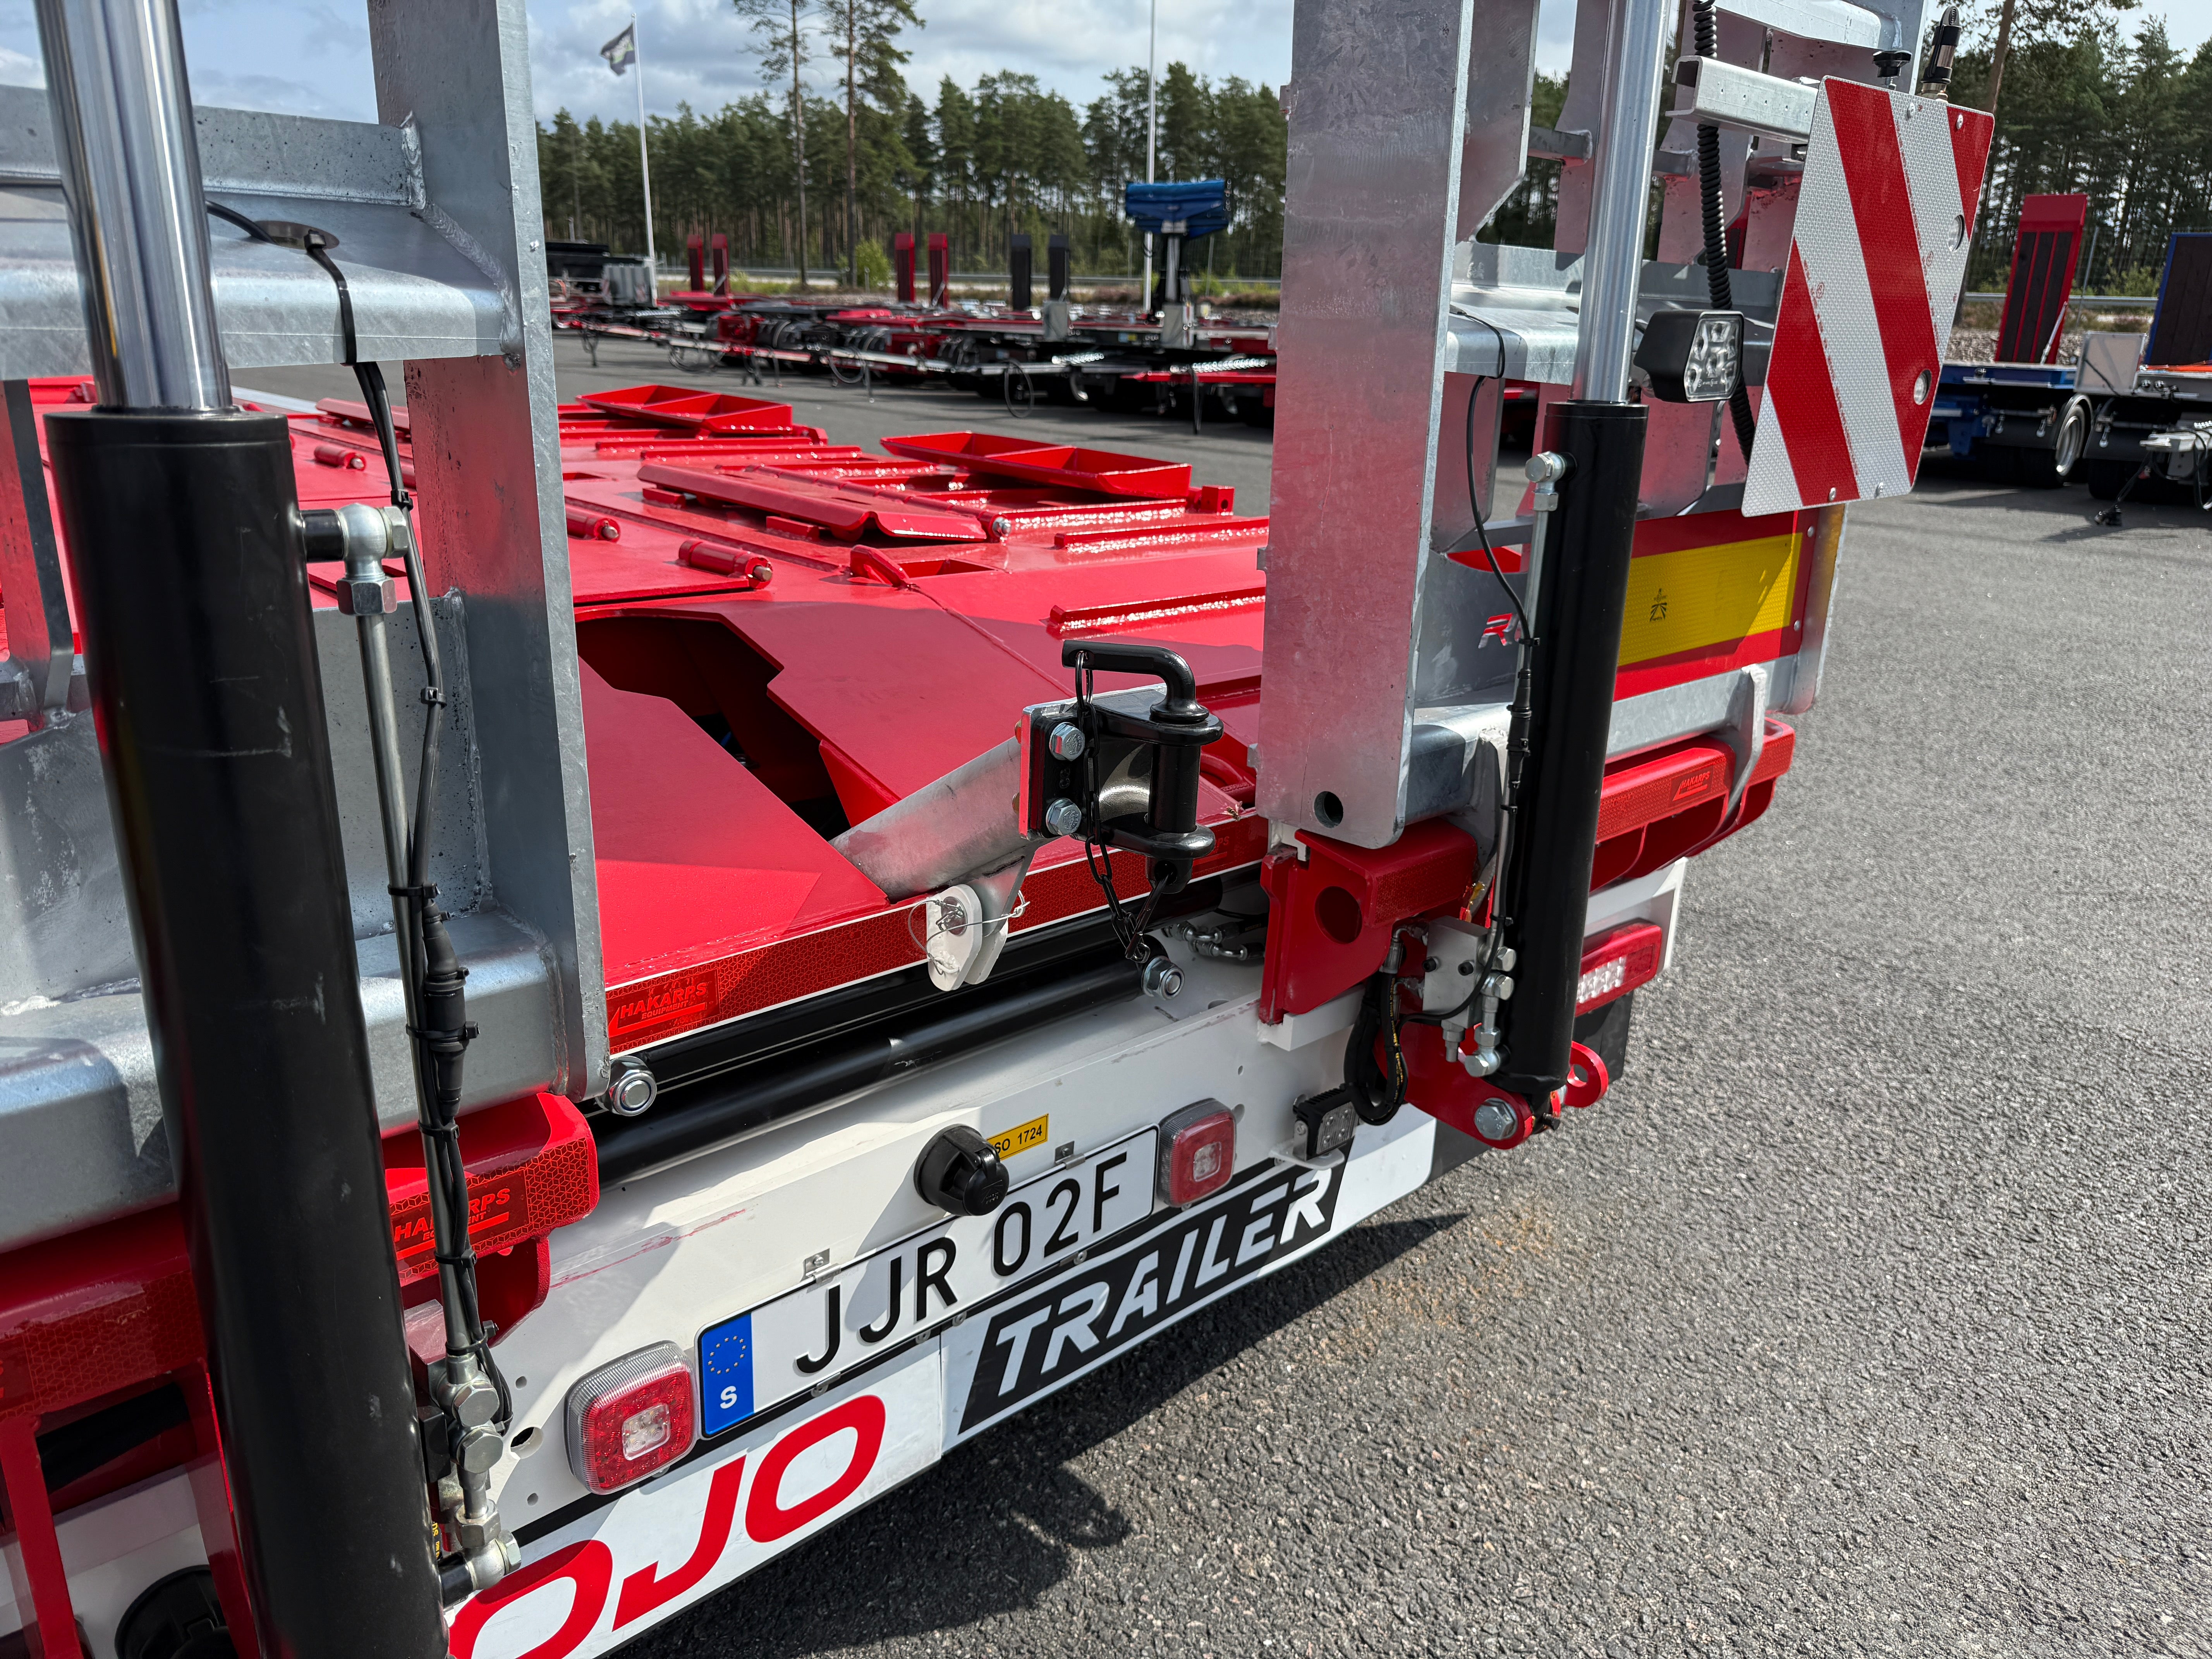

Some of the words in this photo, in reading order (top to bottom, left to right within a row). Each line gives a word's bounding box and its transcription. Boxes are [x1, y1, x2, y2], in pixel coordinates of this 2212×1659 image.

[620, 982, 707, 1019] HAKARPS
[641, 1000, 689, 1020] EQUIPMENT
[994, 1138, 1010, 1154] SO
[1018, 1124, 1042, 1145] 1724
[394, 1188, 510, 1242] HARPS
[795, 1237, 958, 1374] JJR
[991, 1151, 1127, 1276] 02F
[996, 1168, 1332, 1397] TRAILER
[720, 1386, 737, 1409] S
[448, 1394, 886, 1659] OJO
